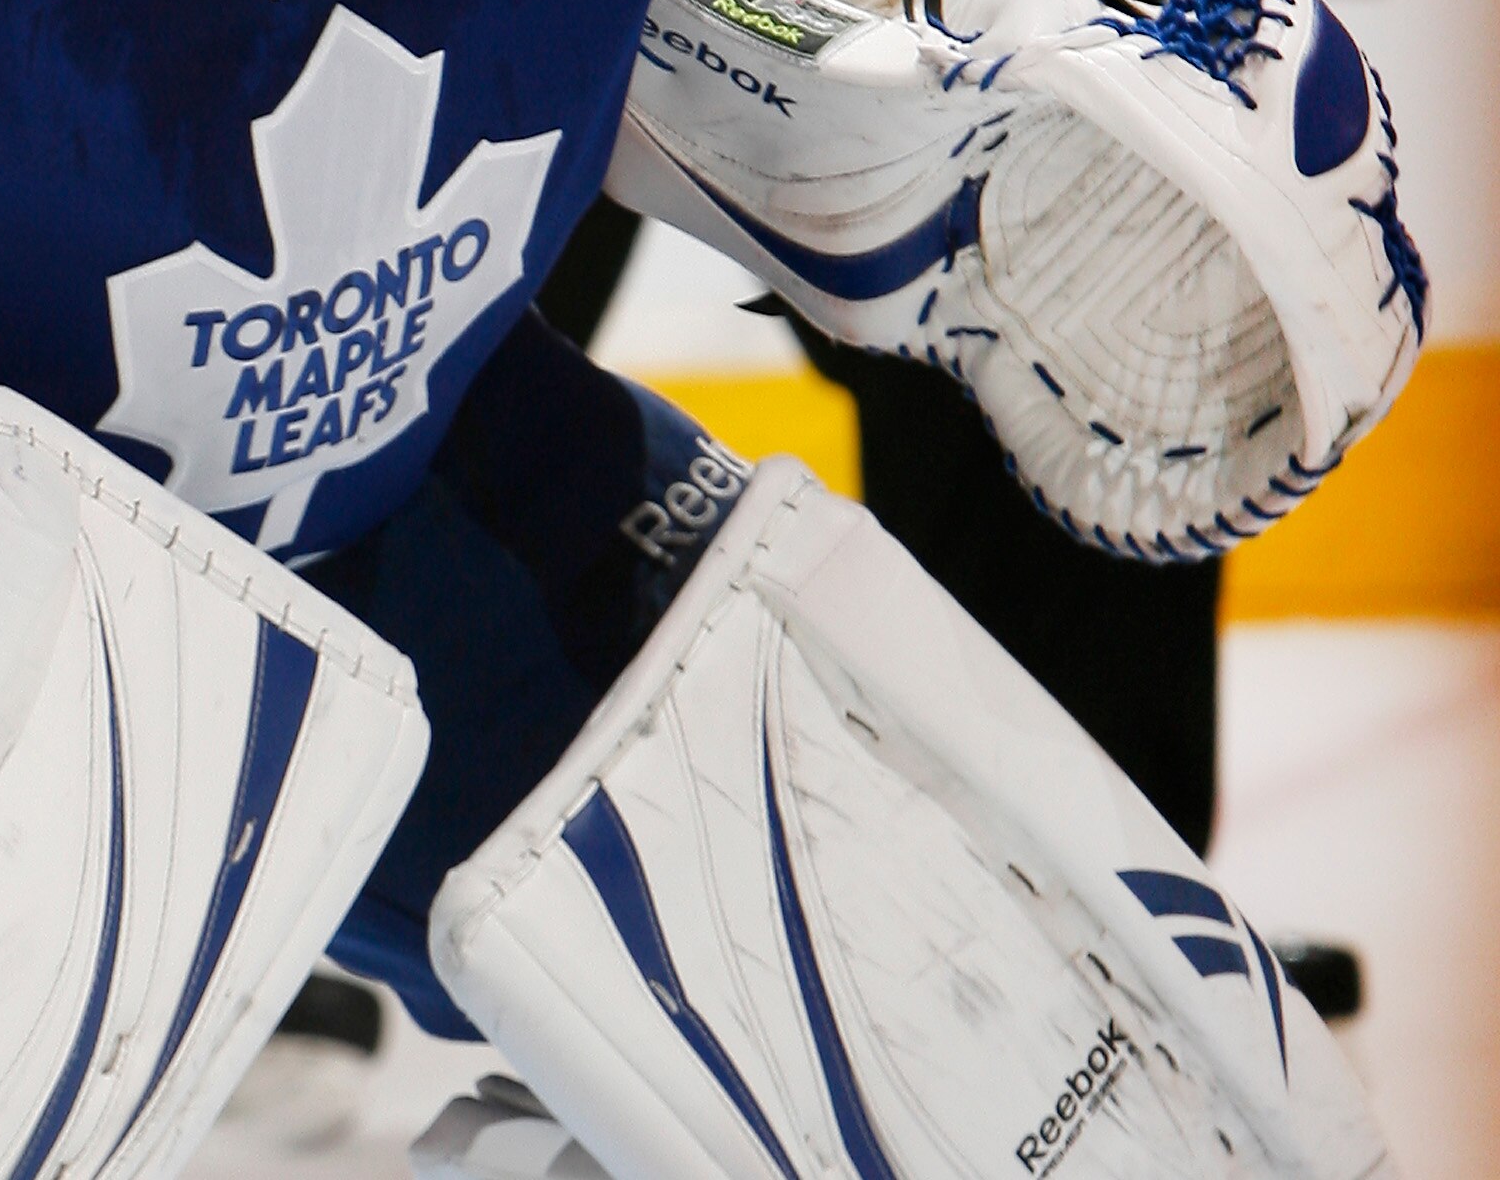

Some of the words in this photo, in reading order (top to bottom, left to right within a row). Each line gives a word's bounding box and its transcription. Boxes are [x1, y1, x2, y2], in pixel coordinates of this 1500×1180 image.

[184, 219, 490, 367] TORONTO
[225, 299, 433, 419] MAPLE
[230, 363, 407, 475] LEAFS
[1016, 1017, 1129, 1174] Reebok
